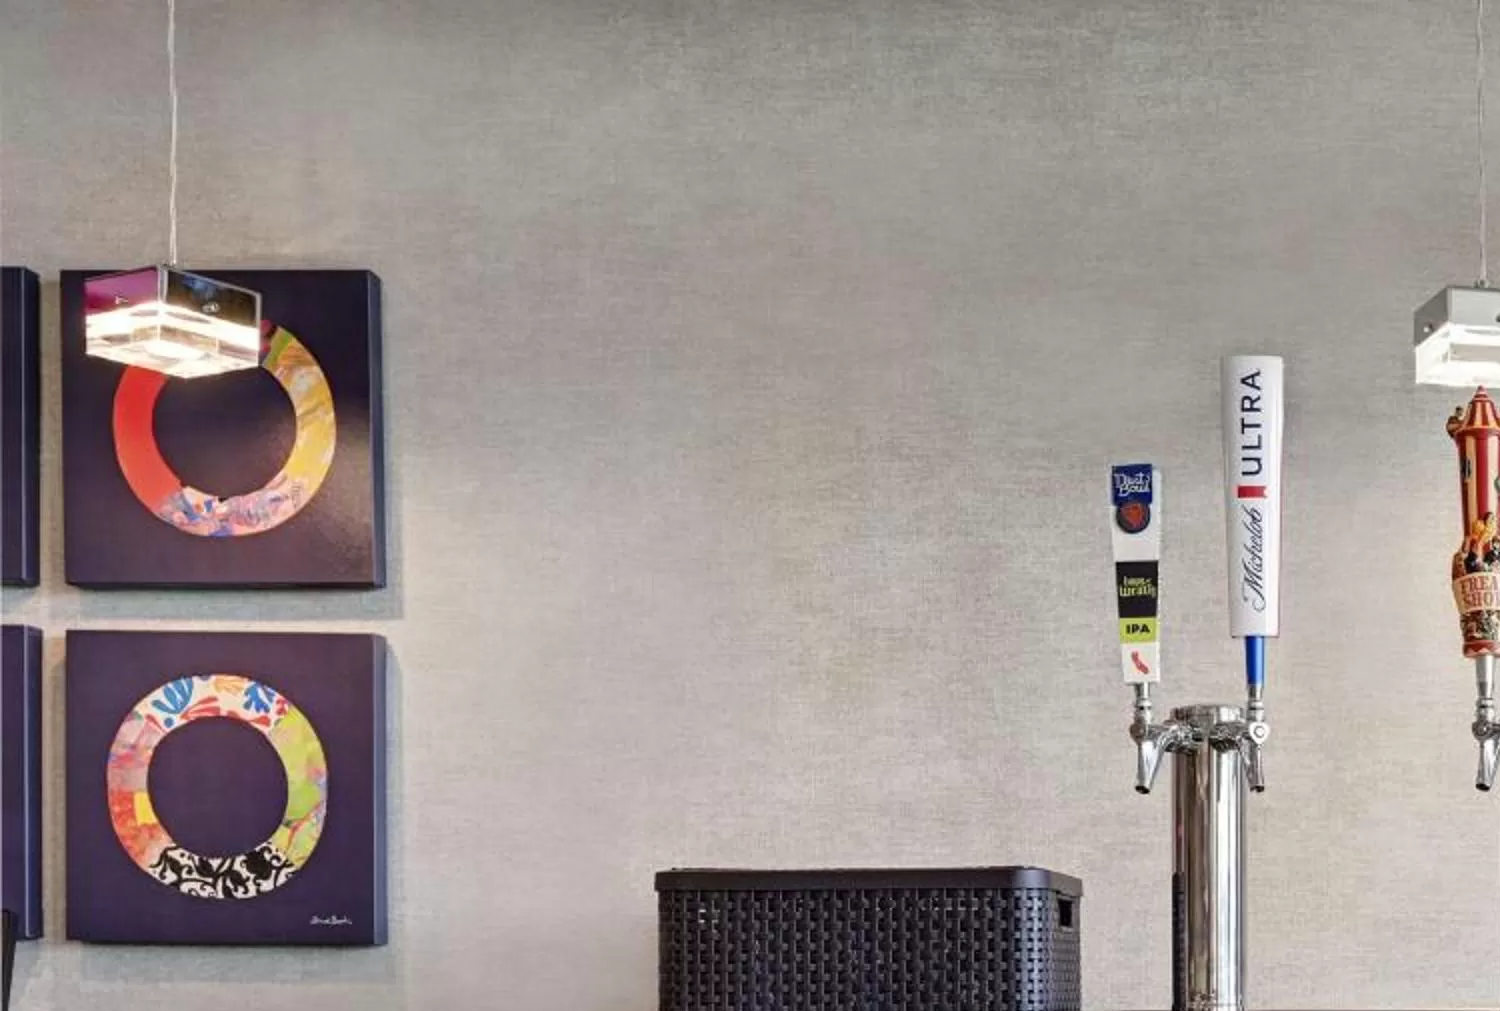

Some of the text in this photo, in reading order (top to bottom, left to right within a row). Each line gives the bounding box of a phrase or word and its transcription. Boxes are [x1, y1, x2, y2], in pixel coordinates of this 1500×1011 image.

[1240, 369, 1266, 612] Michelob ULTRA
[1125, 623, 1151, 635] IPA
